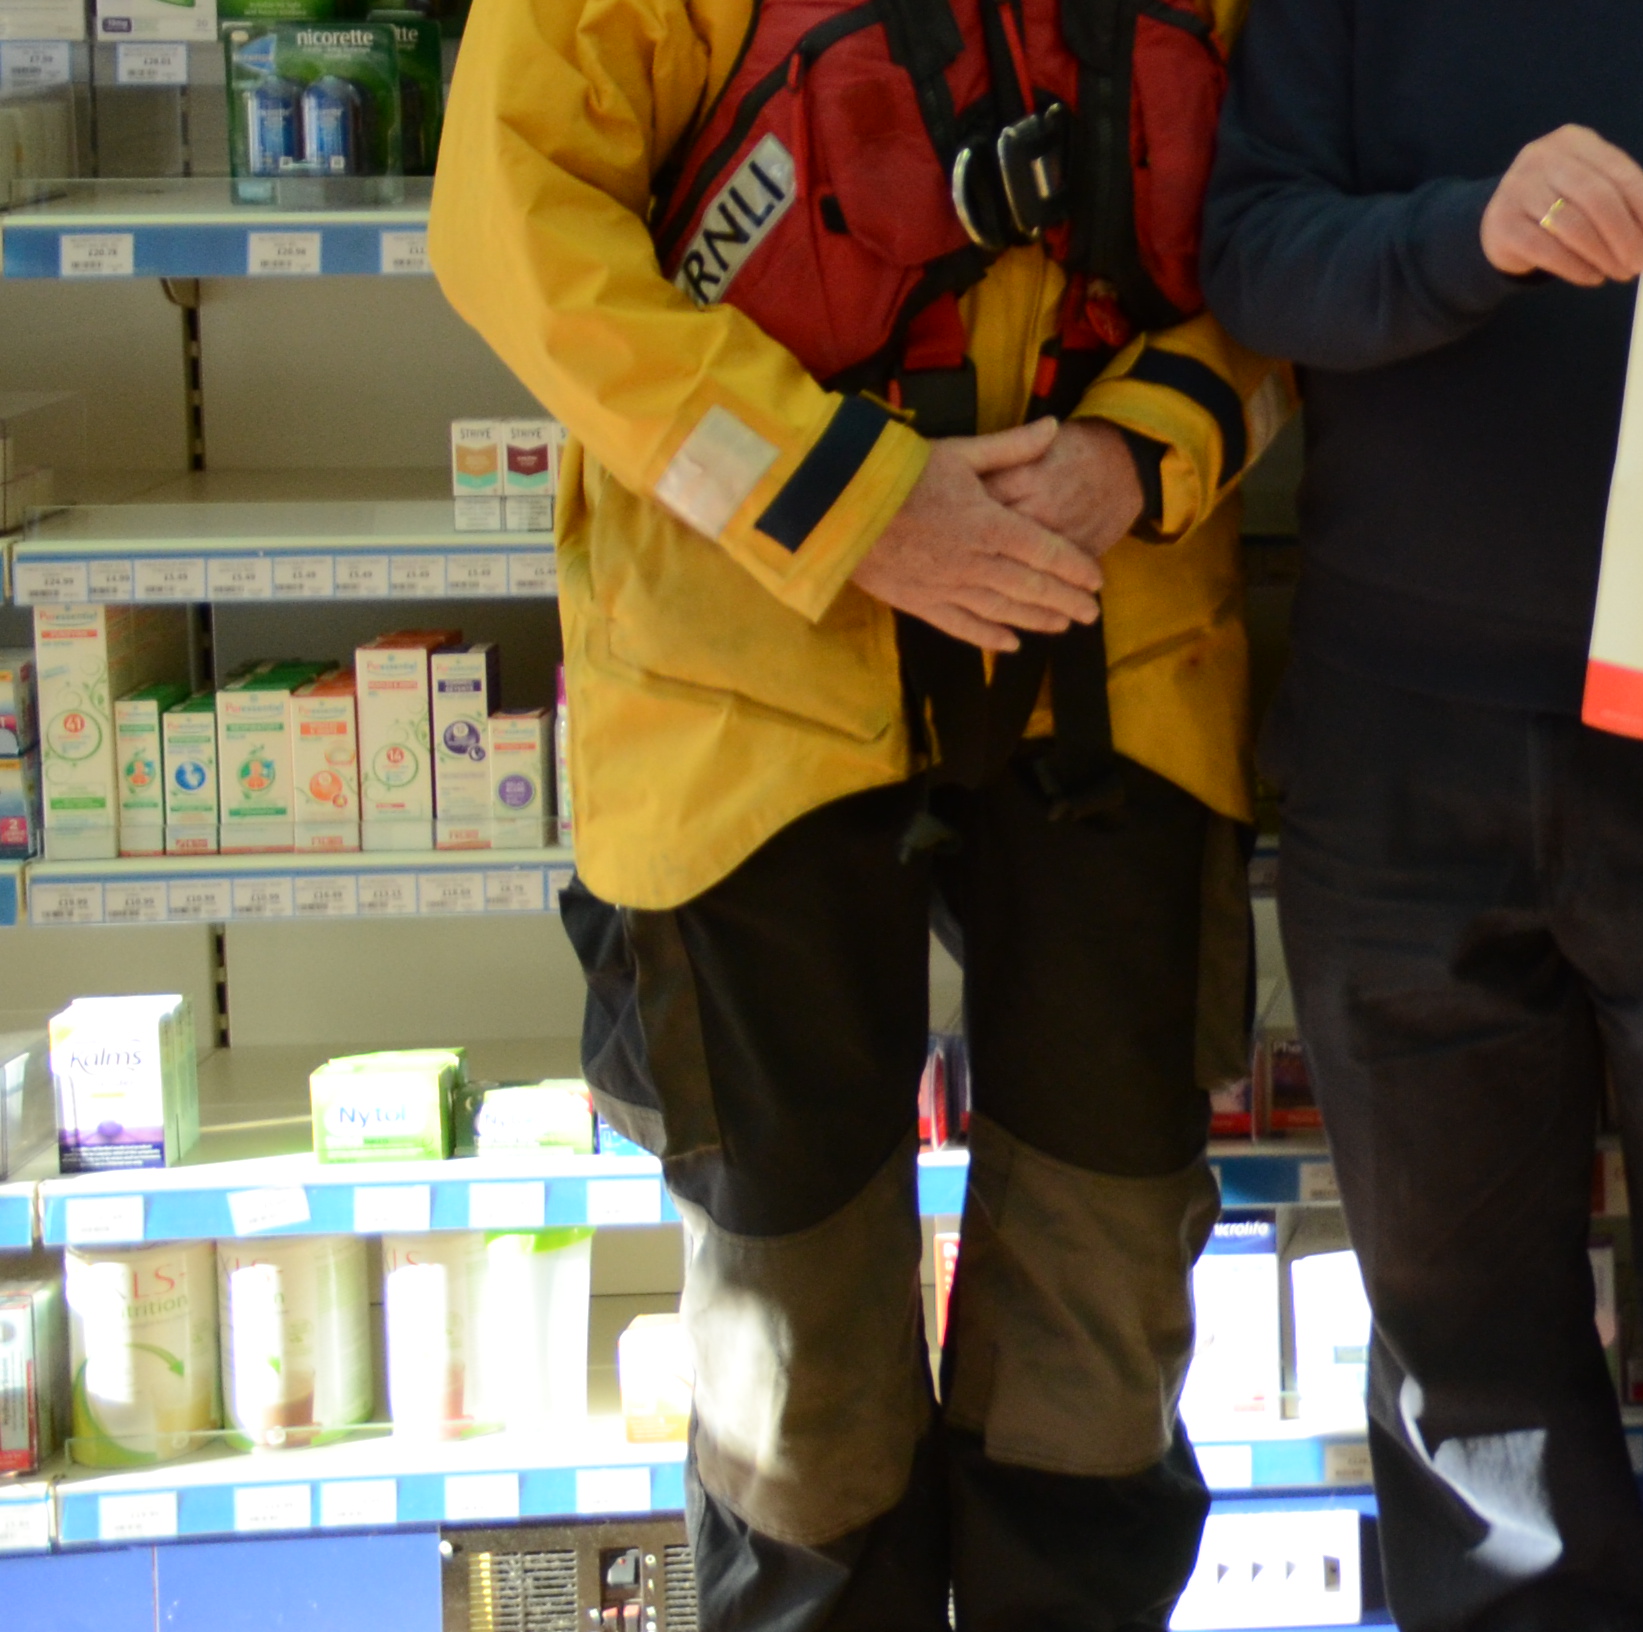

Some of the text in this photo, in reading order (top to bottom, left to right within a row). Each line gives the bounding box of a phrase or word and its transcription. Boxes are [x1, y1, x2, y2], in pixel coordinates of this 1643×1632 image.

[297, 29, 374, 46] nicorette
[682, 160, 785, 304] RNLI
[69, 1044, 143, 1070] Kalms
[337, 1103, 408, 1127] Nytol
